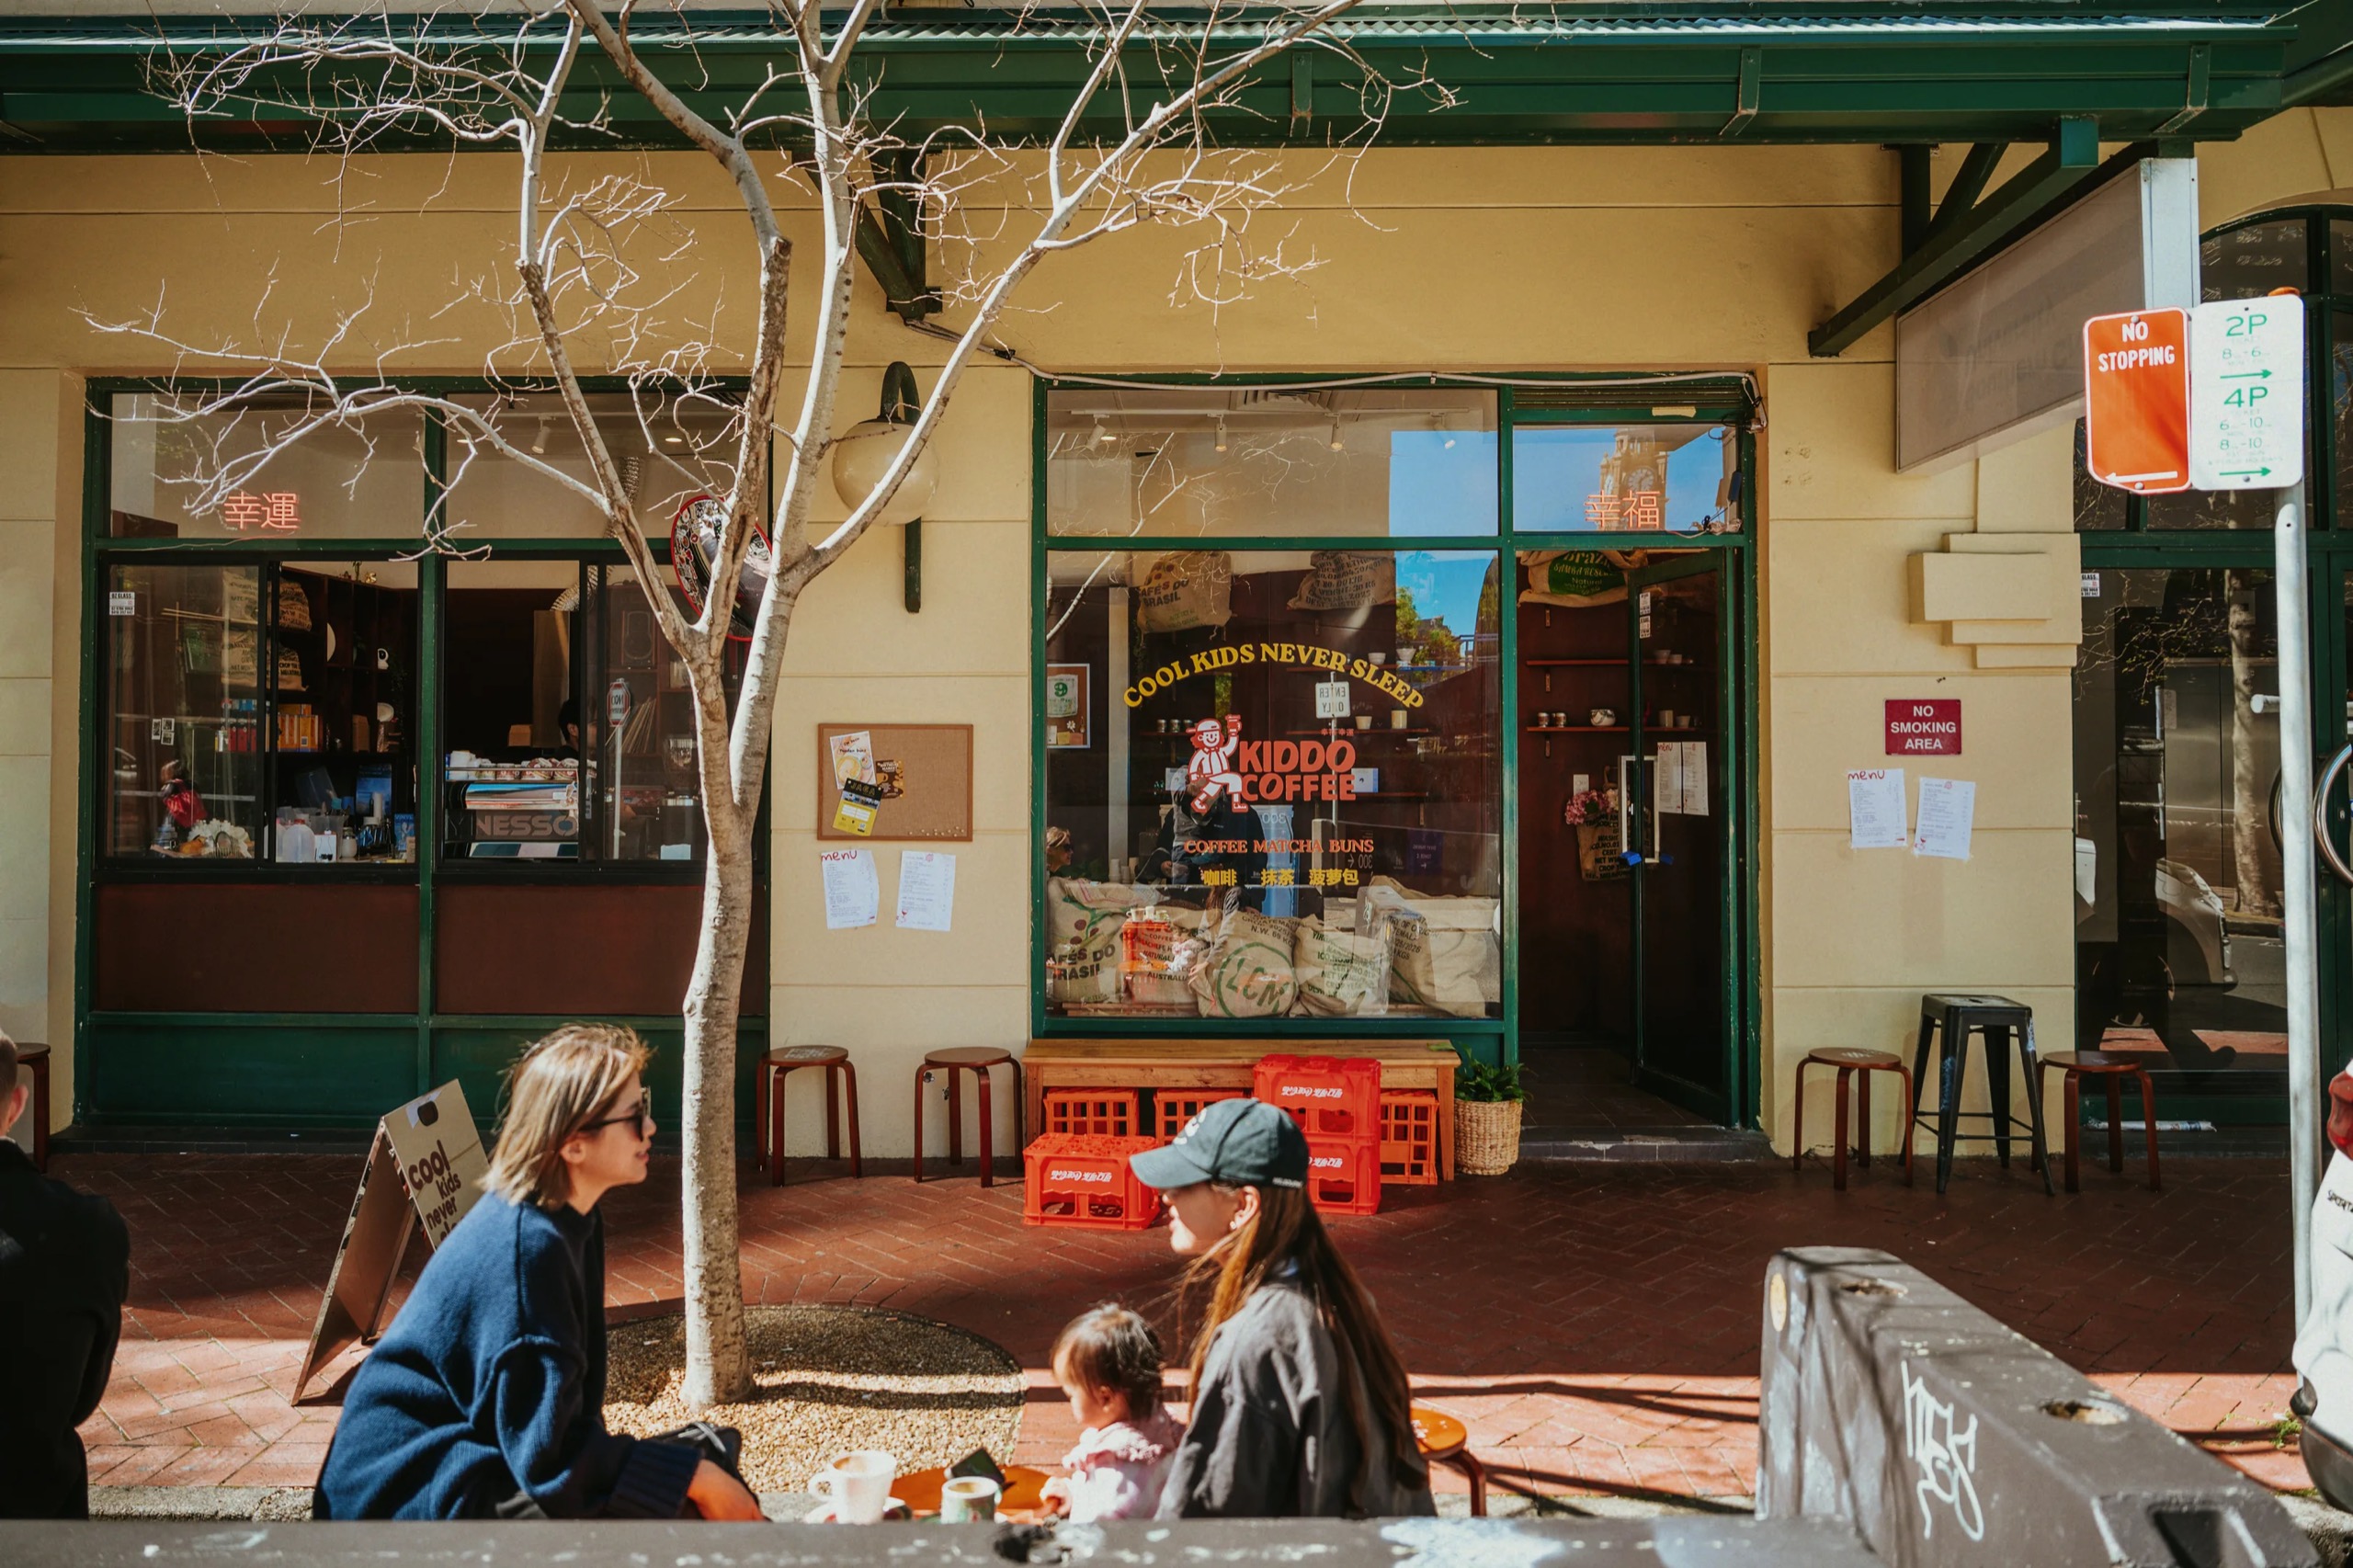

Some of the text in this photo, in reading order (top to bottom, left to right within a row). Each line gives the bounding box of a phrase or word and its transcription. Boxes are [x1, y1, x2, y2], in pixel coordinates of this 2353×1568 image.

[2121, 321, 2149, 343] NO
[2225, 313, 2268, 337] 2P
[2097, 345, 2176, 372] STOPPING
[2223, 386, 2268, 408] 4P
[224, 491, 301, 530] 幸運
[1585, 489, 1661, 528] 幸福
[1173, 578, 1189, 591] DO
[1123, 642, 1425, 709] COOL KIDS NEVER SLEEP
[1054, 682, 1068, 698] 9
[1913, 705, 1934, 717] NO
[1891, 722, 1957, 733] SMOKING
[1904, 738, 1943, 750] AREA
[1239, 740, 1357, 773] KIDDO
[1241, 773, 1357, 801] COFFEE
[1183, 838, 1374, 854] COFFEE MATCHA BUNS
[1203, 869, 1237, 886] 咖啡
[1260, 869, 1294, 886] 抹茶
[1092, 944, 1116, 962] DO
[408, 1139, 451, 1190] cool
[435, 1171, 461, 1200] kids
[426, 1196, 458, 1230] never
